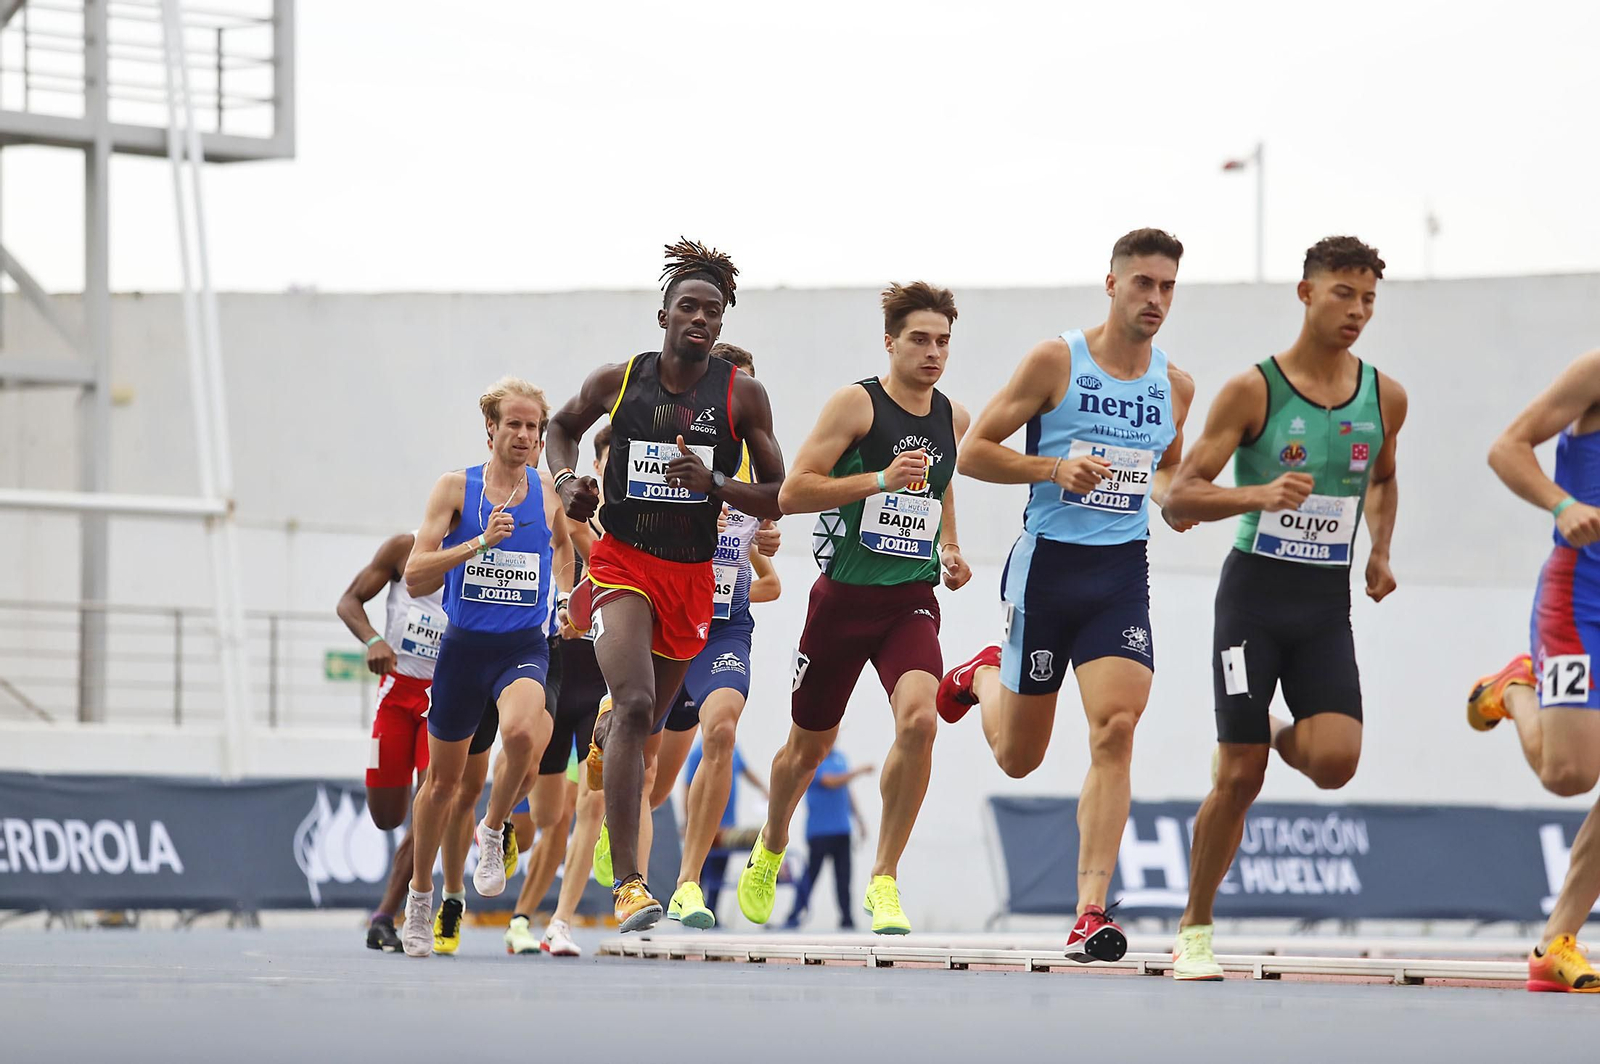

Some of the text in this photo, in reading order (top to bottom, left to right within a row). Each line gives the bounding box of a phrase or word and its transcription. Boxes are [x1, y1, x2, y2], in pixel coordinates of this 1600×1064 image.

[1078, 376, 1102, 390] TROPS
[1078, 392, 1162, 428] nerja
[1090, 424, 1151, 444] ATLETISMO
[1101, 468, 1148, 484] TINEZ
[643, 484, 691, 498] Joma
[1106, 482, 1120, 491] 39
[1081, 490, 1130, 509] Joma
[878, 512, 926, 531] BADIA
[1280, 514, 1339, 533] OLIVO
[898, 528, 911, 537] 36
[1302, 531, 1318, 541] 35
[717, 535, 740, 547] RIO
[876, 536, 919, 553] Joma
[1275, 540, 1331, 559] Joma
[466, 565, 537, 581] GREGORIO
[497, 579, 510, 587] 37
[478, 587, 523, 601] Joma
[1546, 660, 1587, 698] 12
[1186, 811, 1371, 856] UTACIÓN
[1239, 856, 1363, 895] HUELVA
